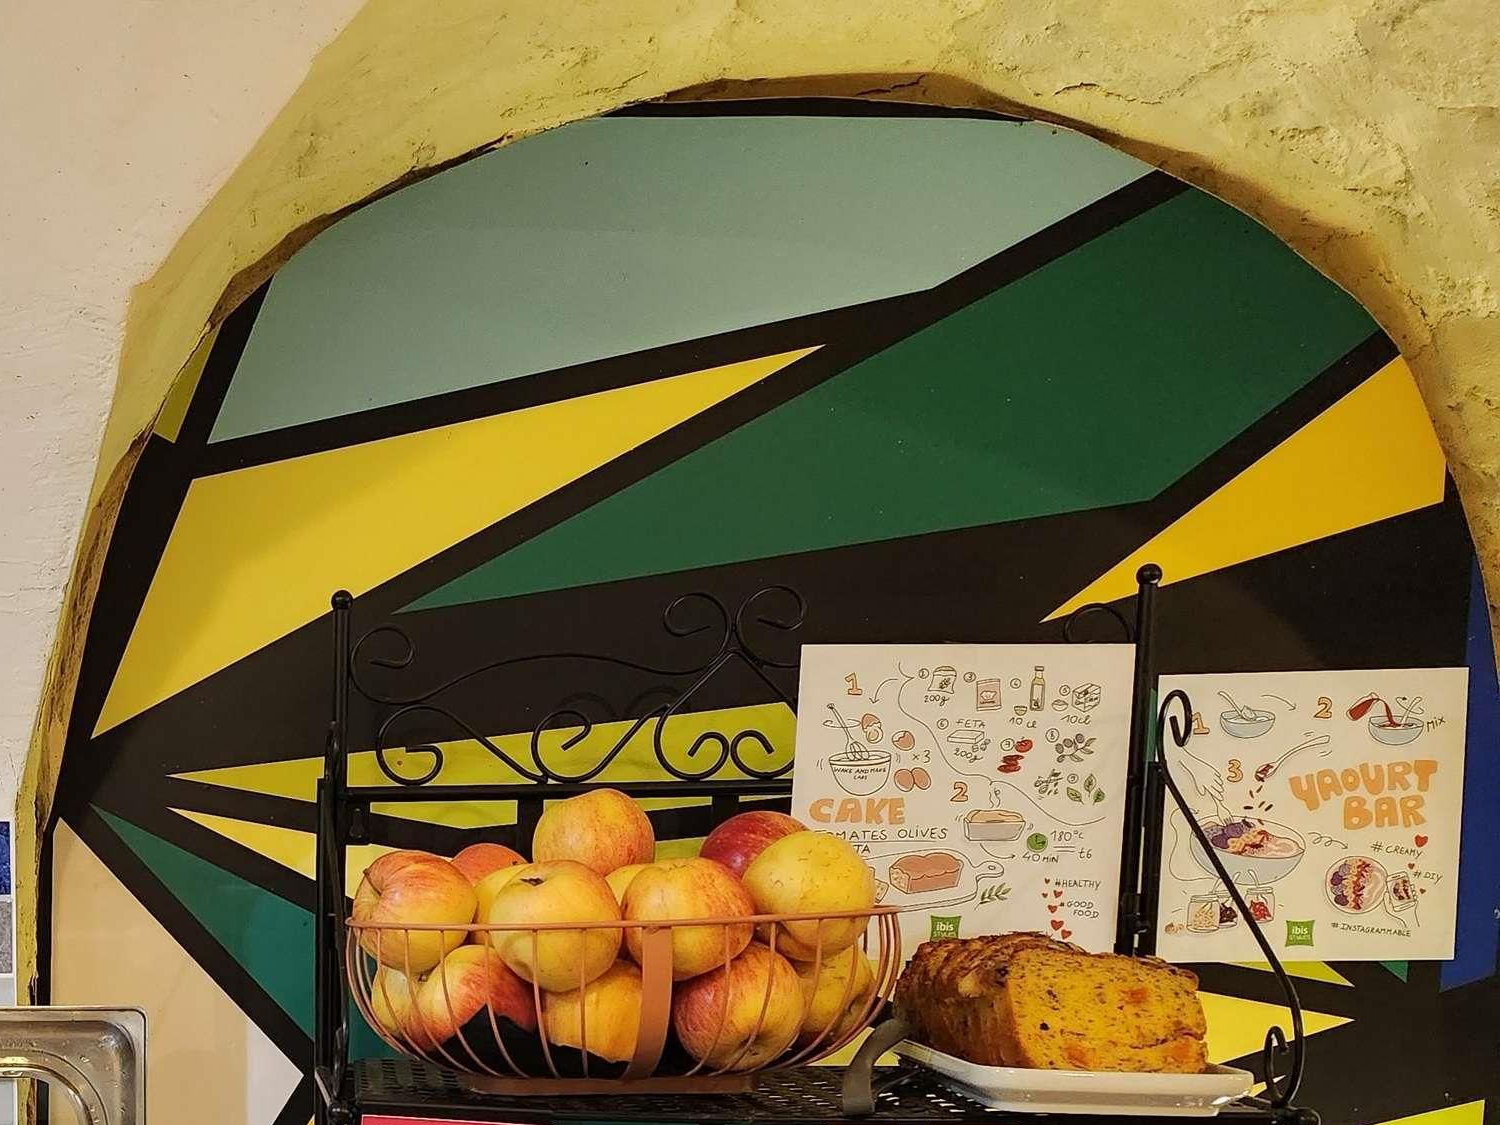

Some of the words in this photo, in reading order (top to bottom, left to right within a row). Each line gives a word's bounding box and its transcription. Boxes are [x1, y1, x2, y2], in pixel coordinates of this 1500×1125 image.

[845, 673, 863, 695] 1
[924, 694, 950, 706] 200g
[1313, 697, 1332, 718] 2
[956, 718, 986, 728] FETA
[1009, 717, 1023, 726] 10
[1192, 711, 1210, 735] 1
[954, 748, 983, 763] 200g
[1226, 759, 1244, 782] 3
[950, 782, 968, 802] 2
[1289, 760, 1438, 811] YAOURT
[809, 797, 905, 825] CAKE
[1344, 795, 1427, 830] BAR
[814, 829, 888, 841] MATES
[1021, 853, 1040, 863] 40
[1073, 909, 1100, 919] FOOD
[936, 921, 954, 931] ibis
[1291, 925, 1308, 935] ibis
